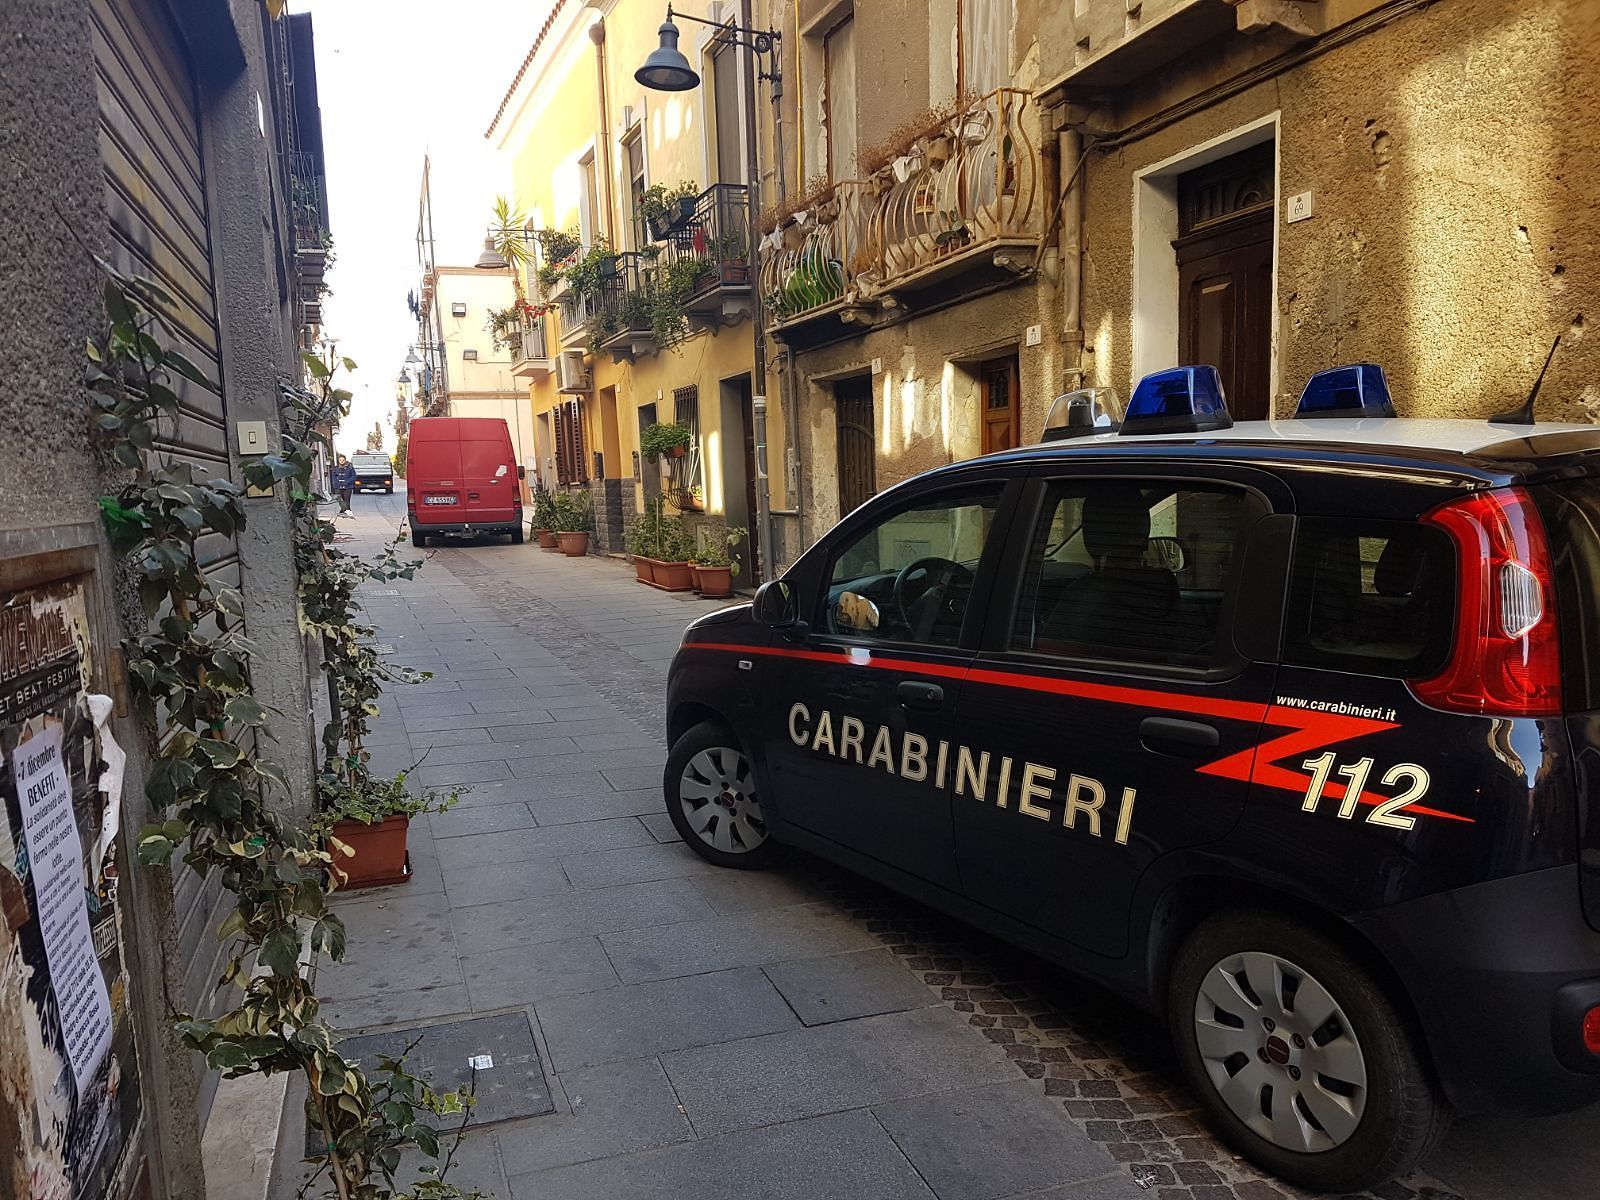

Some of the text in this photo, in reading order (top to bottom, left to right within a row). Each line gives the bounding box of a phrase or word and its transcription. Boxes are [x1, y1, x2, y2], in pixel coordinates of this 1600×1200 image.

[16, 681, 43, 704] BEAT
[1276, 695, 1397, 722] www.carabinieri.it
[27, 744, 56, 777] dicembre
[788, 702, 1137, 845] CARABINIERI
[27, 771, 56, 808] BENEFIT
[1301, 751, 1430, 831] 112
